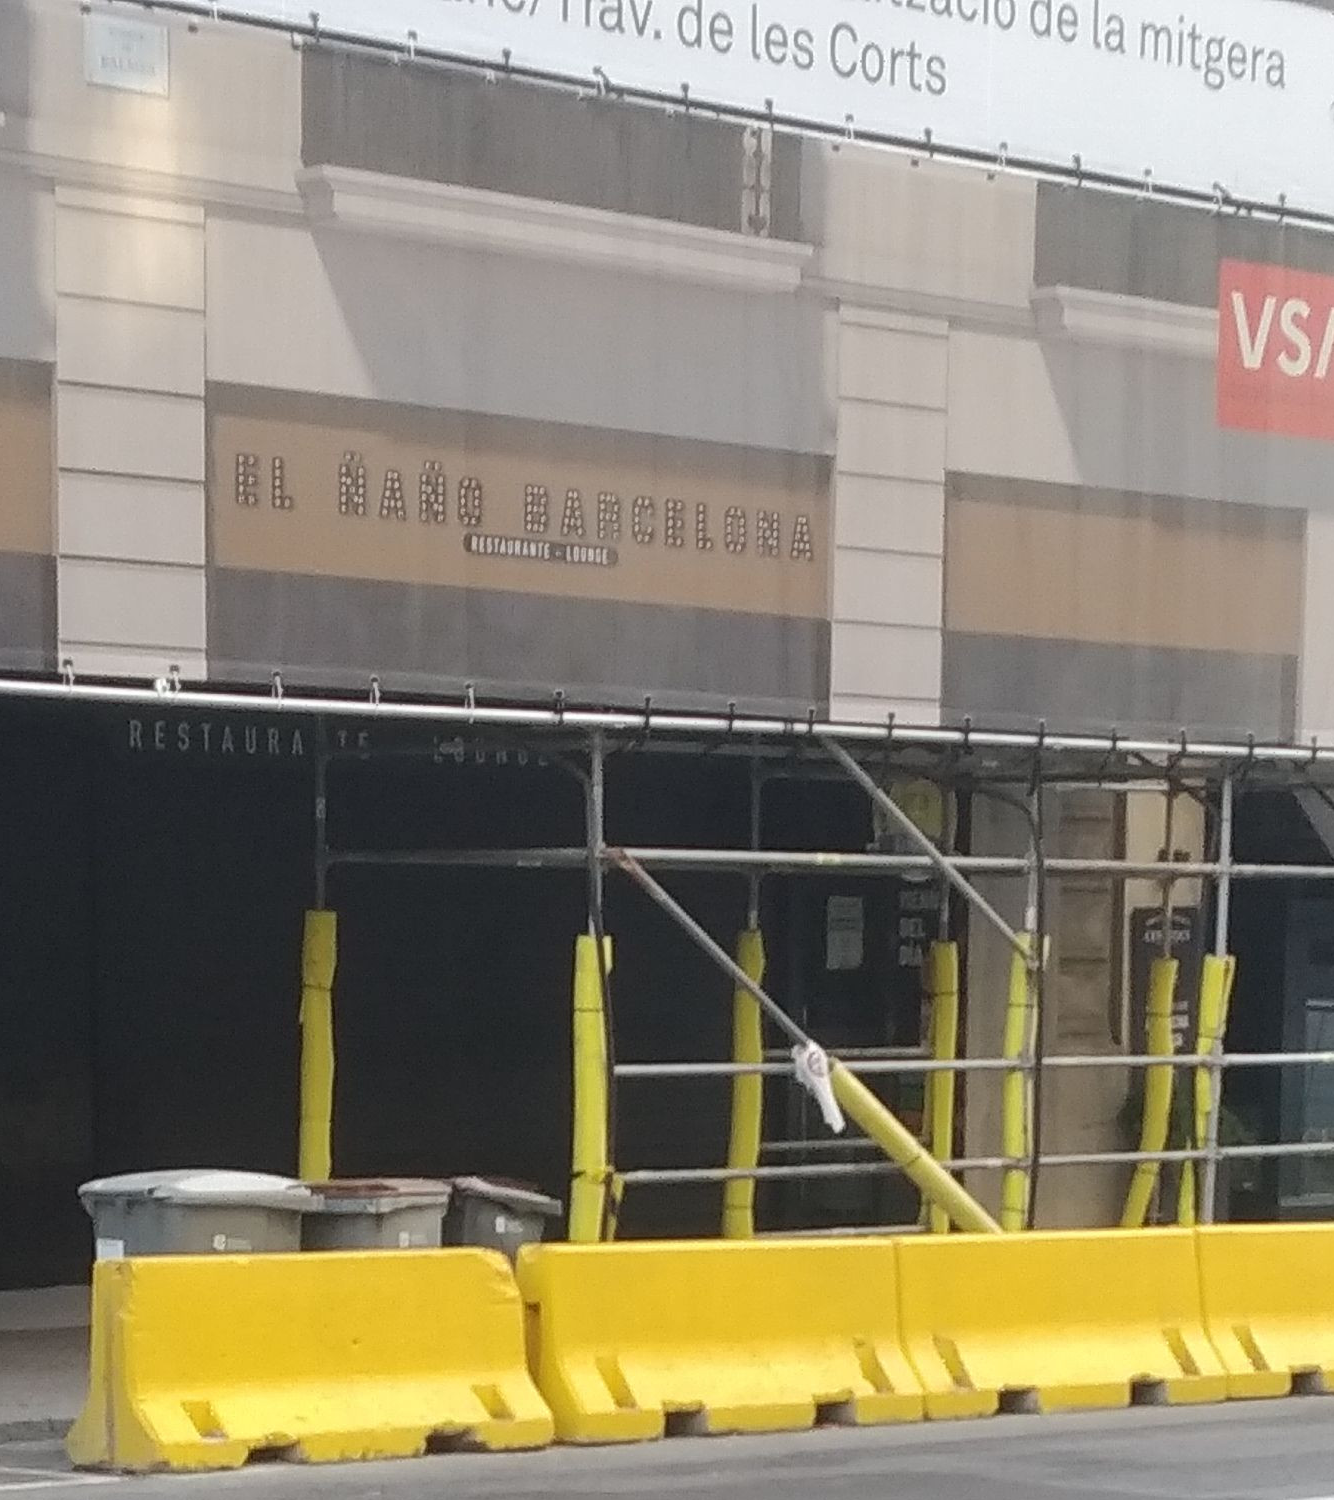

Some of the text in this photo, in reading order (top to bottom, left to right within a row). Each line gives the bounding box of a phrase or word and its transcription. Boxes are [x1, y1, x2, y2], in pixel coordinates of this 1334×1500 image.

[677, 0, 734, 54] de
[750, 2, 815, 71] les
[829, 21, 948, 96] Corts
[1029, 0, 1079, 42] de
[1092, 0, 1127, 54] la
[1138, 15, 1287, 91] mitgera
[235, 452, 295, 510] EL
[524, 484, 815, 562] BARCELONA
[128, 719, 369, 760] RESTAURATE
